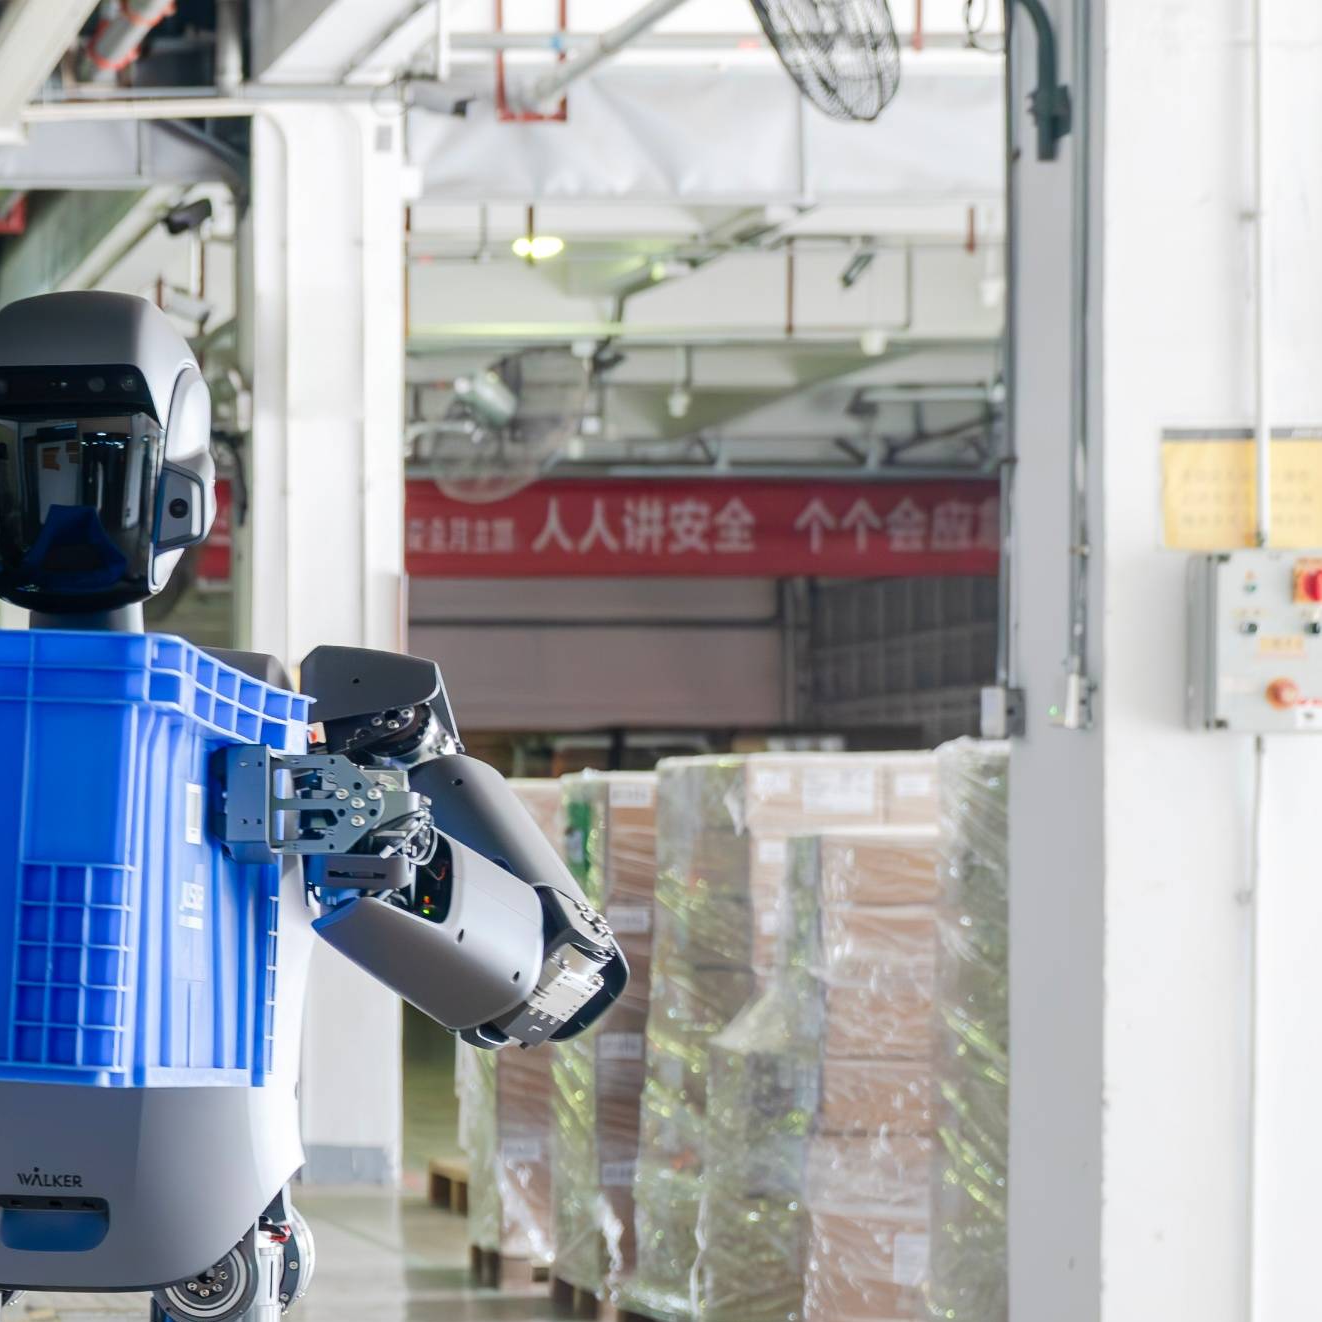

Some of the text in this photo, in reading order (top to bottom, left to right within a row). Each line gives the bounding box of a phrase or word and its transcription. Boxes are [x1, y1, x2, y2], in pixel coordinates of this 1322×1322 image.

[533, 498, 755, 553] 人人讲安全
[17, 1167, 83, 1188] WALKER
